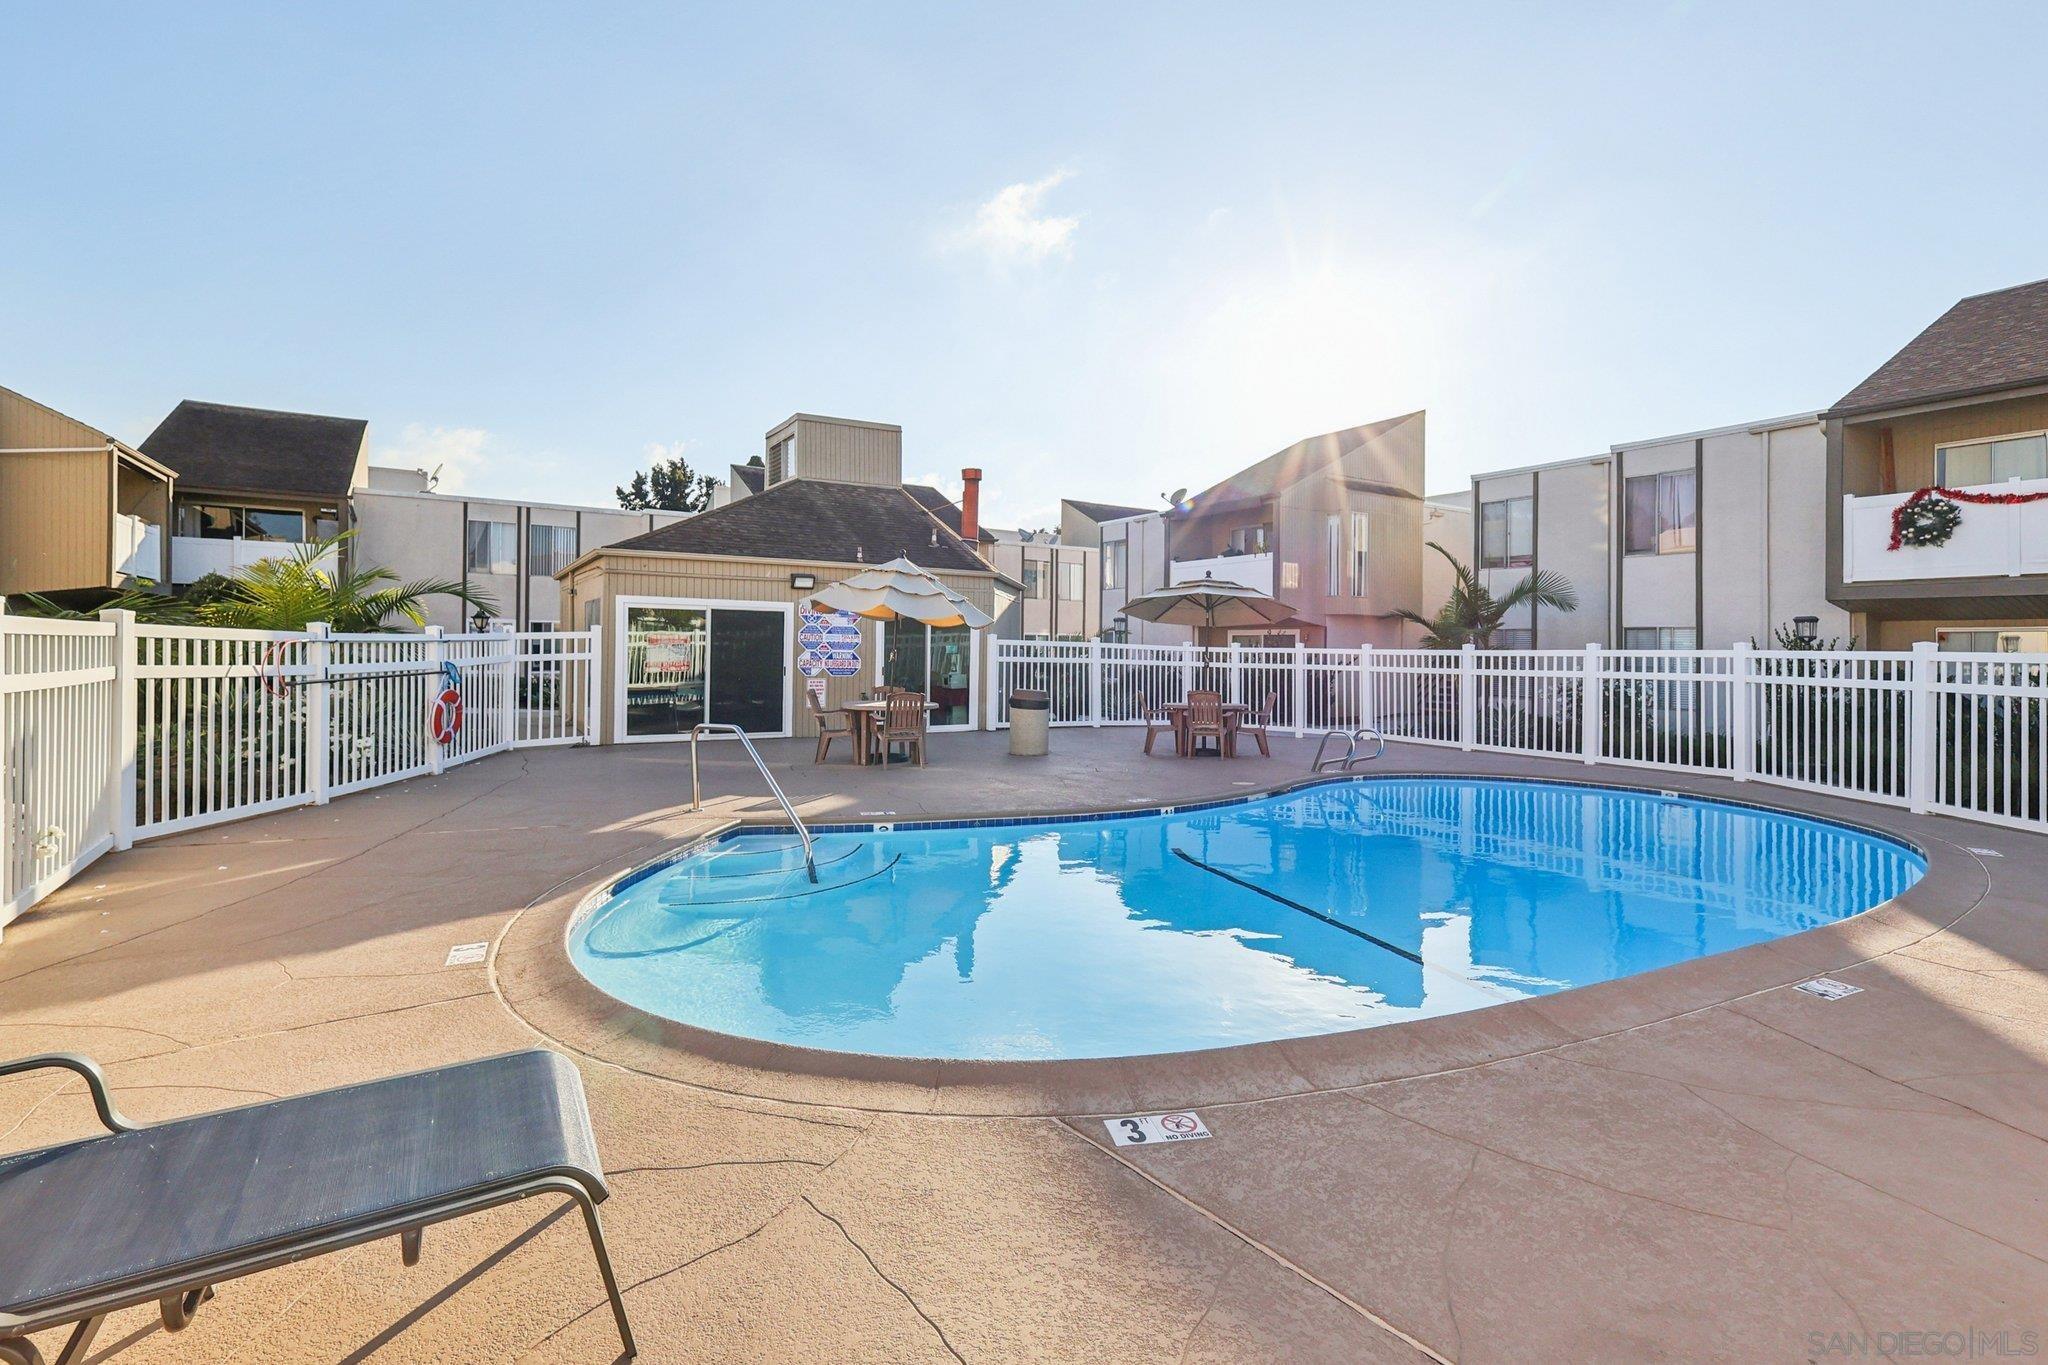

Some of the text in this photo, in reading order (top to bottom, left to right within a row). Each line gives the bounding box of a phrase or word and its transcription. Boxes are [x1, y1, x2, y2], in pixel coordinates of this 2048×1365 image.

[833, 652, 854, 660] WARNING
[1120, 1117, 1149, 1143] 3 FT
[1180, 1131, 1210, 1139] DIVING
